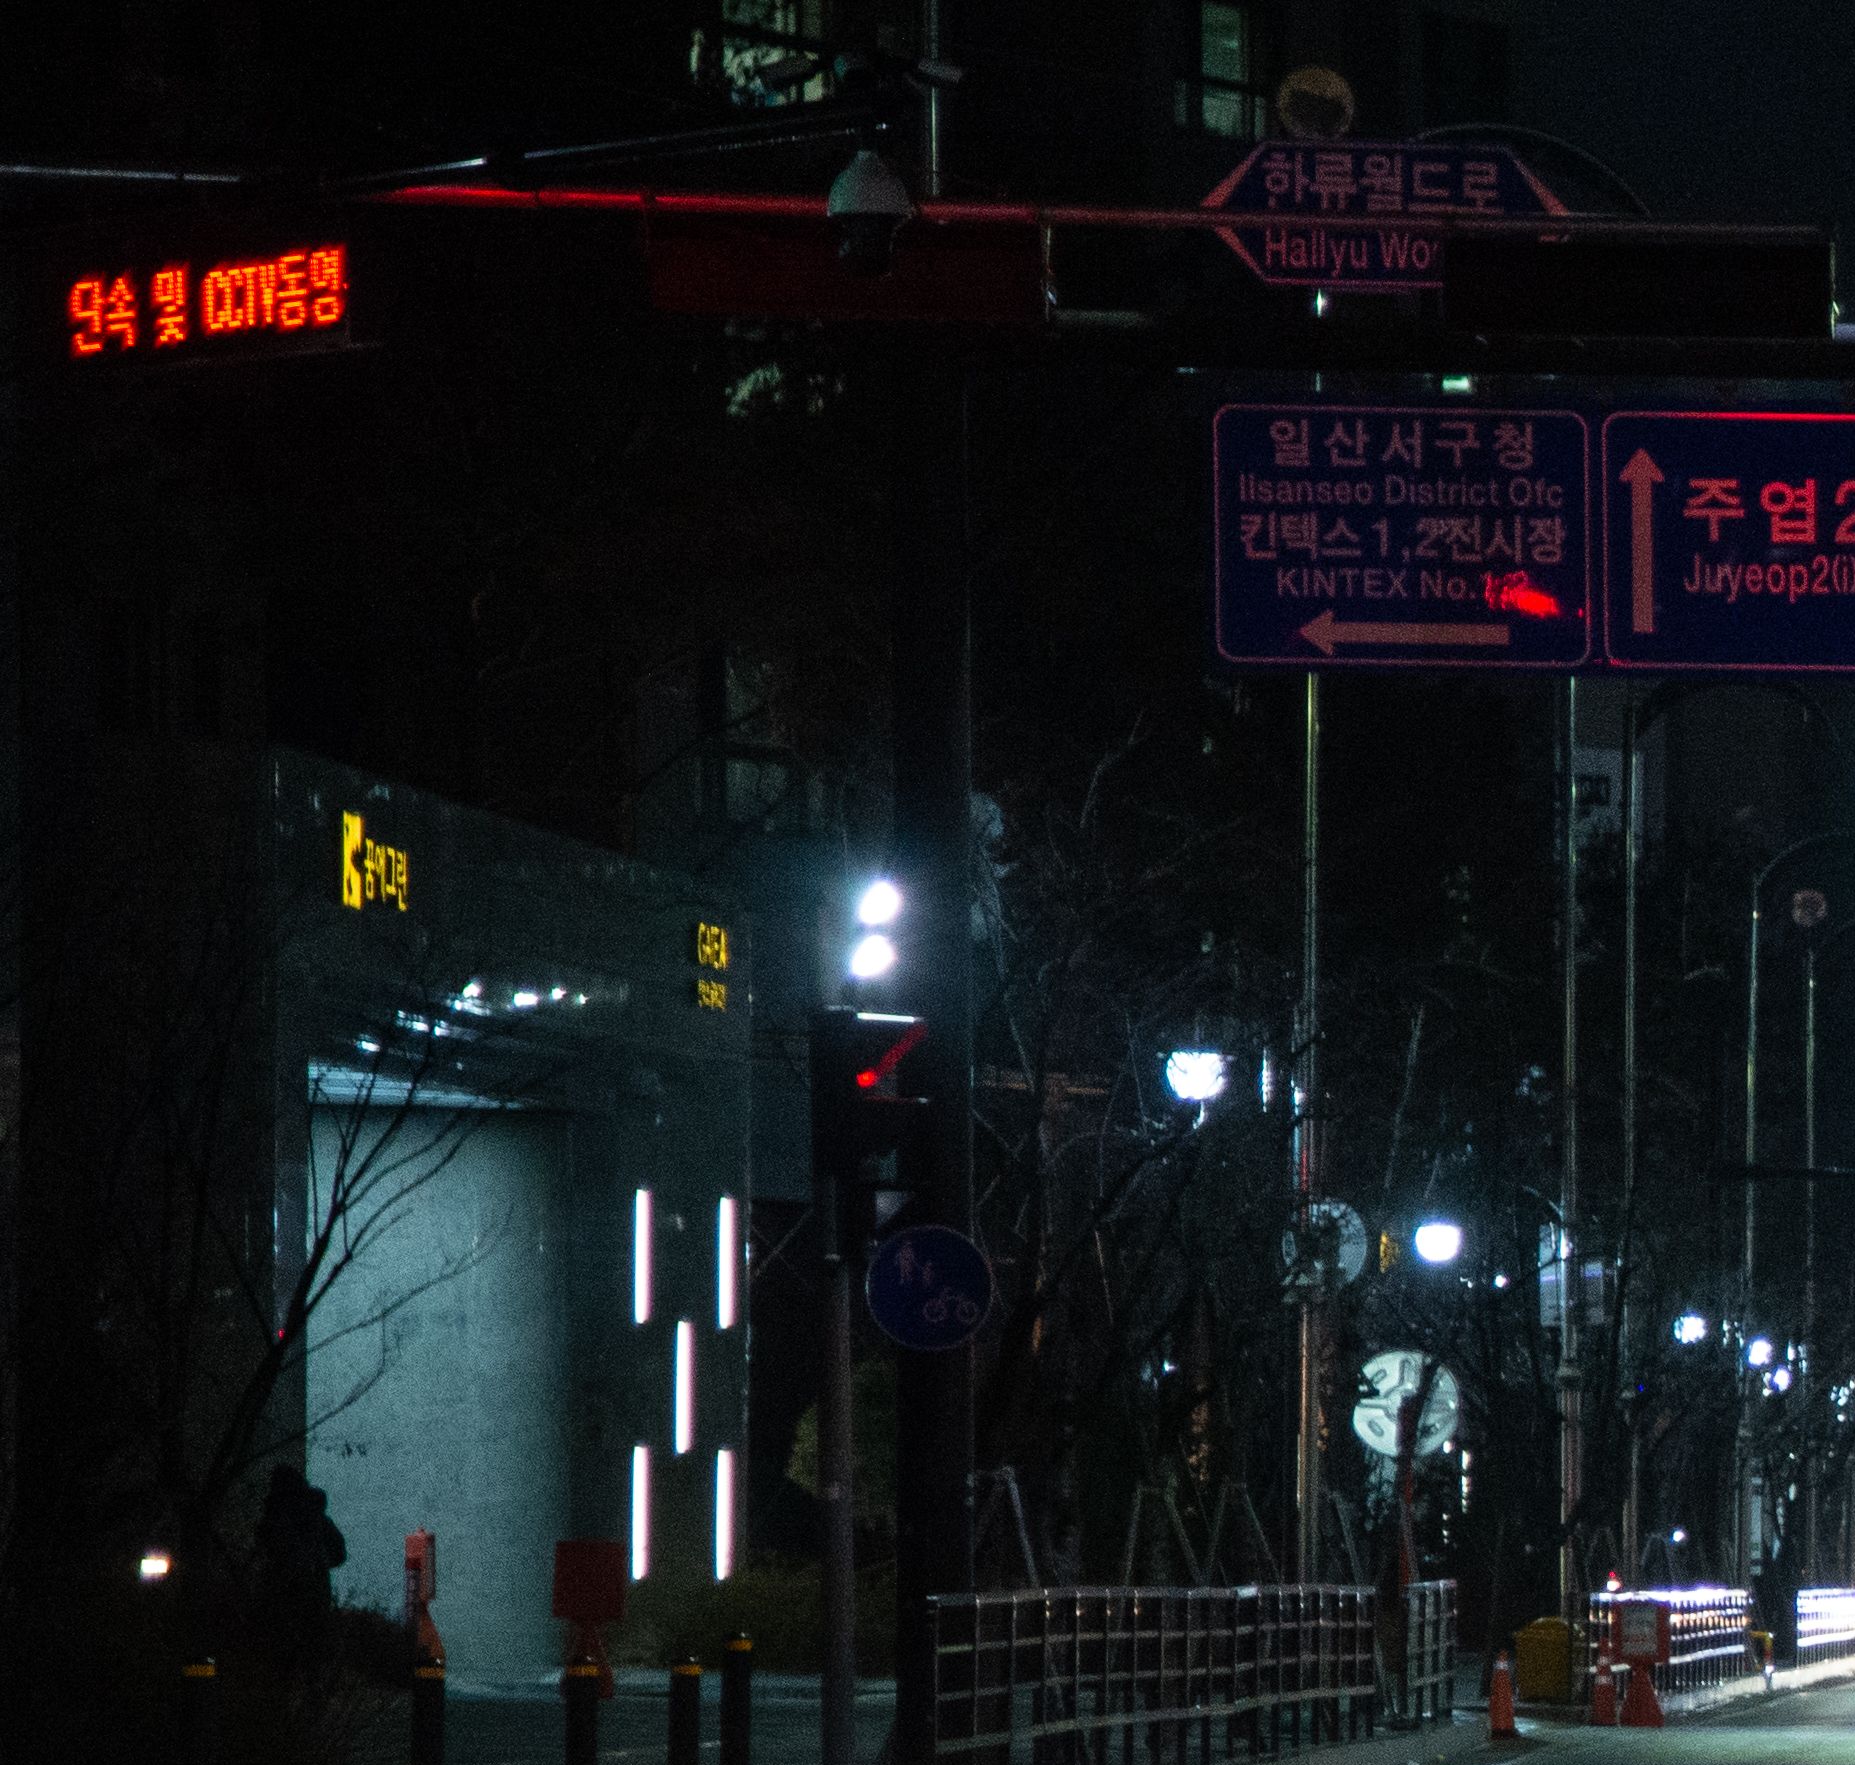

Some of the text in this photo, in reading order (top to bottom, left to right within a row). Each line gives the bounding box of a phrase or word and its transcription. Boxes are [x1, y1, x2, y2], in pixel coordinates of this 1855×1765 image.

[1260, 152, 1505, 214] 한류월드로
[1264, 229, 1367, 276] Hallyu
[153, 268, 186, 344] 및
[1267, 418, 1537, 472] 일산서구청
[1237, 472, 1566, 509] Ilsanseo District Ofc
[1275, 566, 1409, 600] KINTEX
